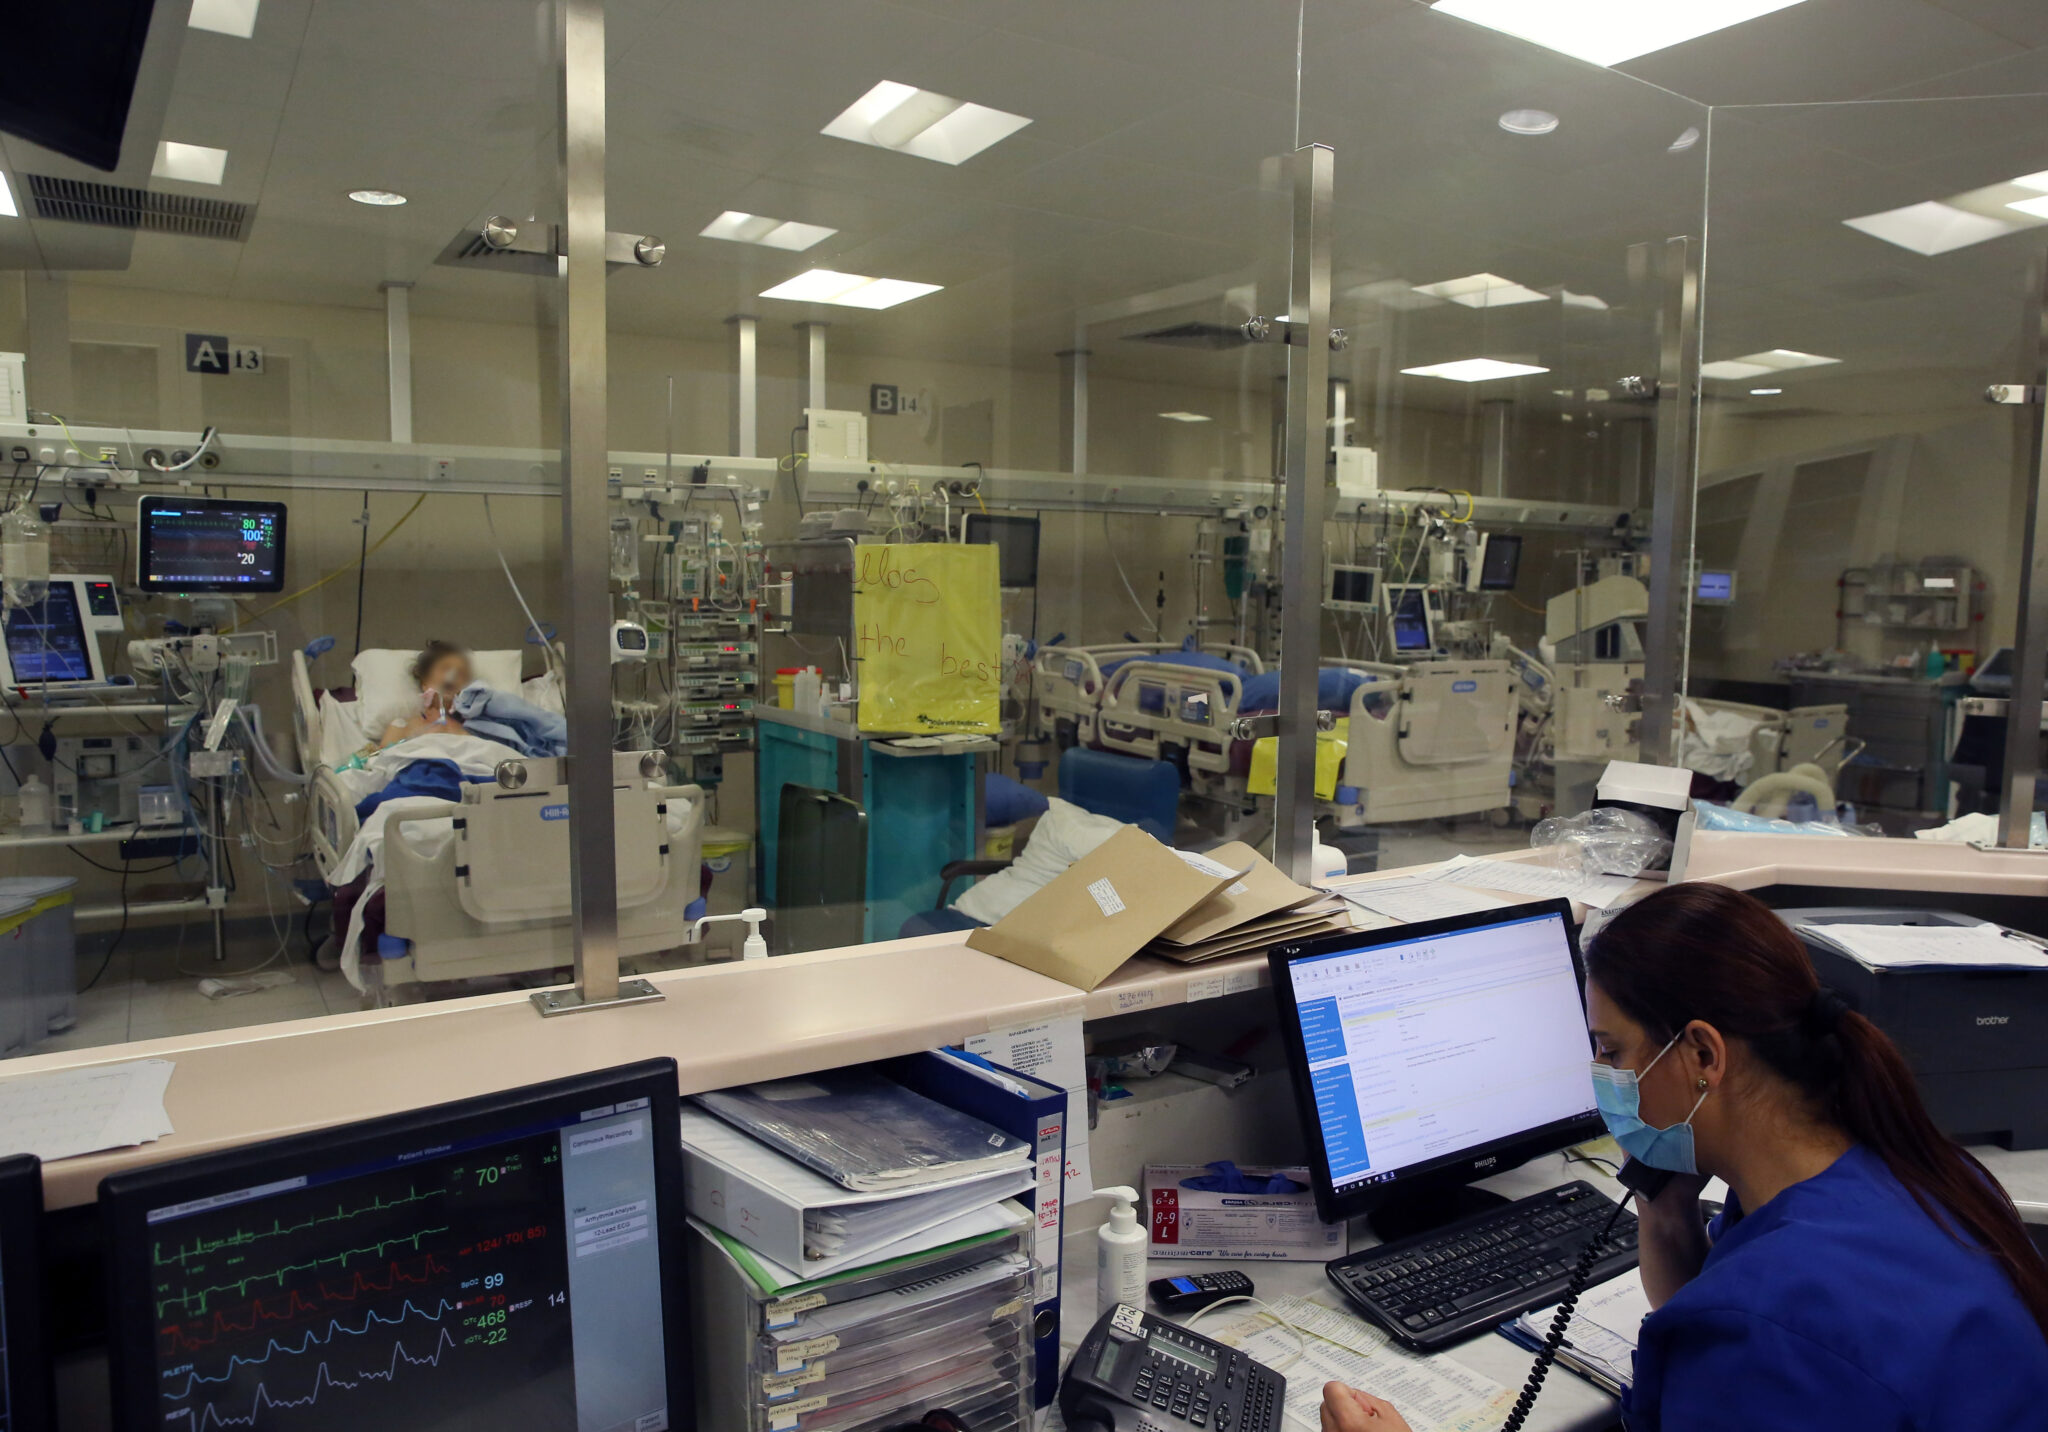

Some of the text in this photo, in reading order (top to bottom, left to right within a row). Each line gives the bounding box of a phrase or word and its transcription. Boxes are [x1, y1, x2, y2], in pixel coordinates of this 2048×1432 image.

[193, 340, 260, 370] A 13
[876, 388, 918, 413] B 14
[240, 553, 256, 565] 20
[859, 623, 910, 658] the
[941, 642, 1006, 683] best
[544, 807, 569, 818] Hill-R
[1976, 1015, 2010, 1026] brother
[572, 1129, 633, 1149] Continuous Recording
[398, 1150, 423, 1161] Patient
[1474, 1156, 1497, 1168] PHILIPS
[475, 1166, 499, 1187] 70
[614, 1204, 637, 1217] Analysis
[1155, 1211, 1176, 1224] 8-9
[616, 1220, 631, 1231] ECG
[484, 1272, 504, 1290] 99
[514, 1290, 566, 1310] RESP 14
[477, 1309, 506, 1329] 468
[482, 1327, 508, 1346] -22
[162, 1364, 194, 1378] PLETH
